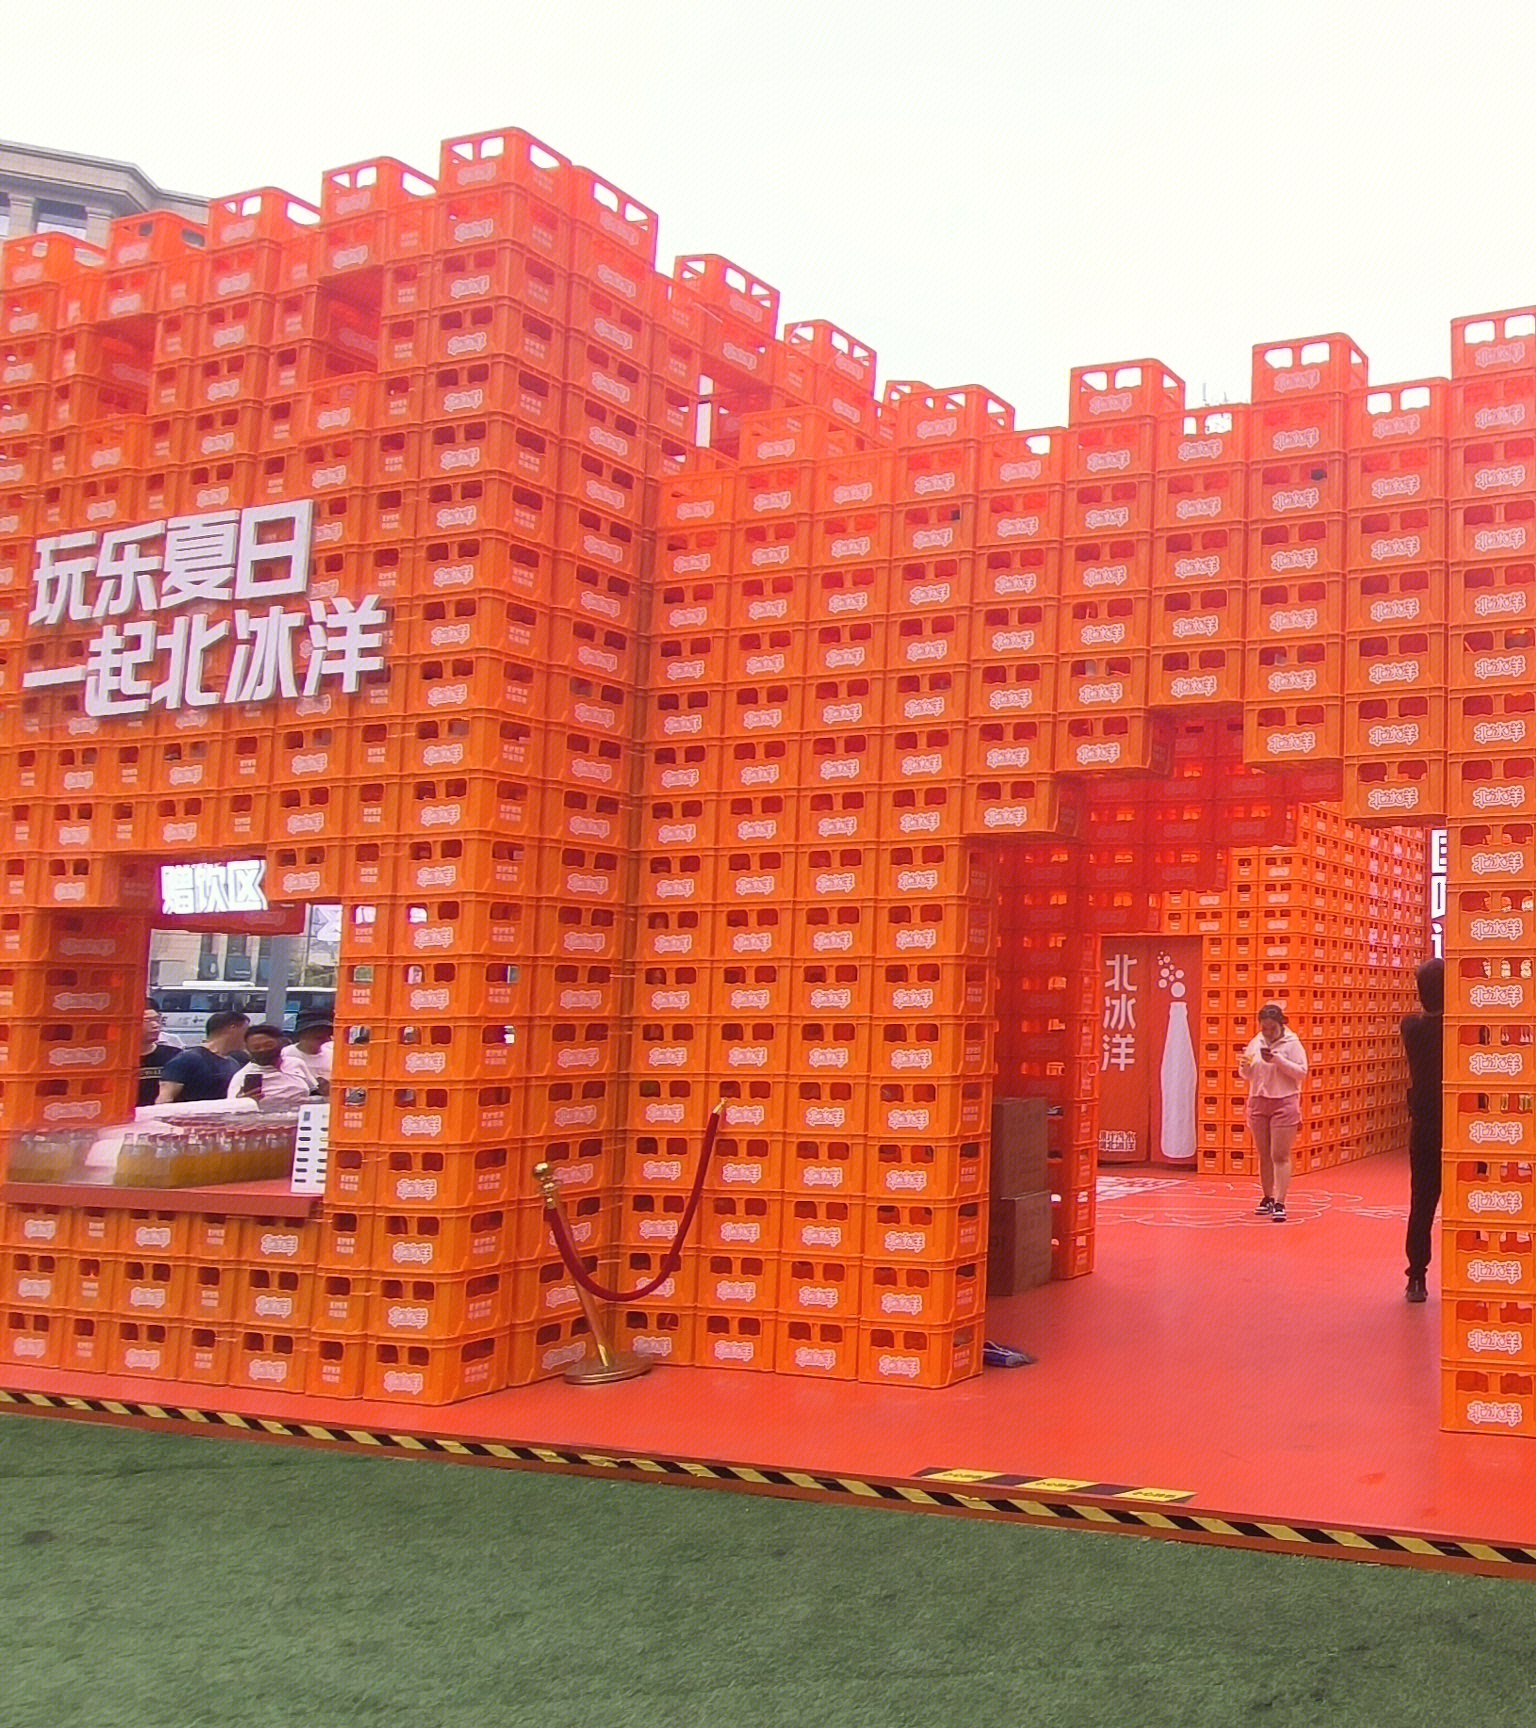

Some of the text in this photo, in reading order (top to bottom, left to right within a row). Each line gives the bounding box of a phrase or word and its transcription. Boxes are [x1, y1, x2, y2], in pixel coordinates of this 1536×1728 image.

[28, 499, 314, 627] 玩乐夏日
[23, 594, 387, 718] 一起北冰洋
[1101, 954, 1138, 1072] 北冰洋
